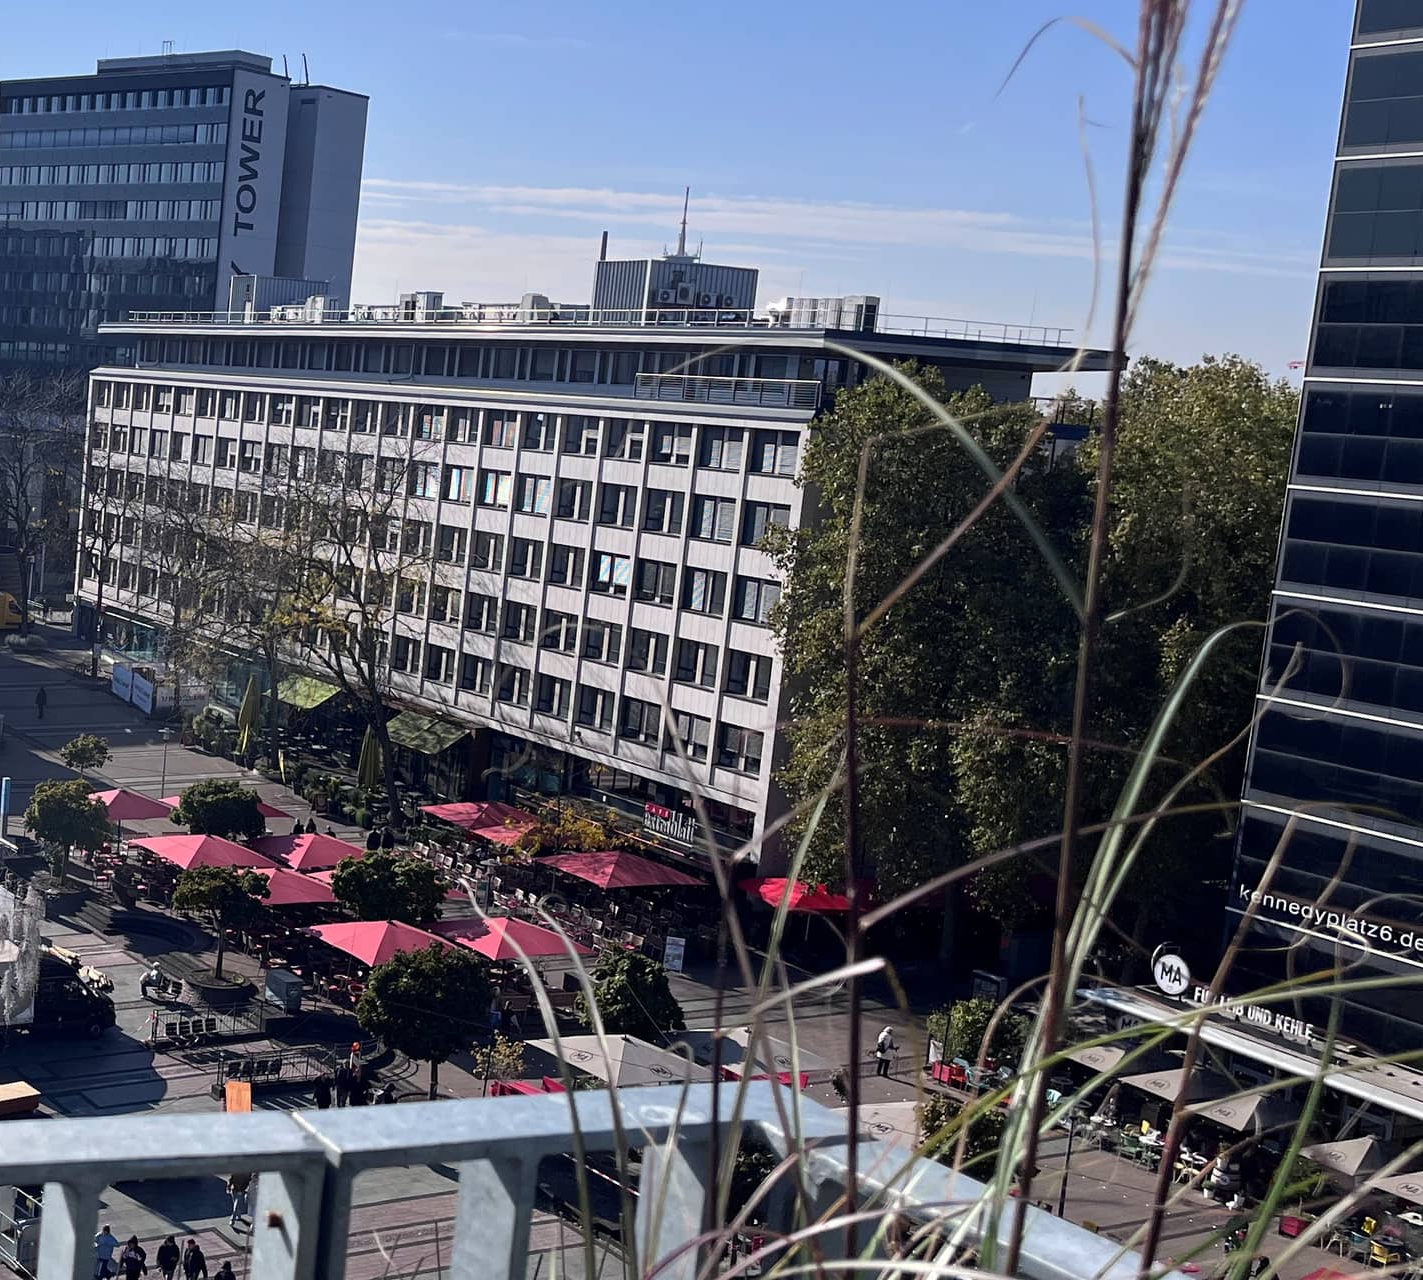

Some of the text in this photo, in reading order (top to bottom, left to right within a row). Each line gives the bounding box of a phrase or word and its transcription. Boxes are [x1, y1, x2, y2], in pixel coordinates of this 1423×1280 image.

[233, 88, 266, 237] TOWER
[1239, 884, 1423, 951] kennedyplatz6.de
[1160, 961, 1183, 987] MA
[1247, 1004, 1272, 1025] UND
[1275, 1013, 1317, 1041] KEHLE.
